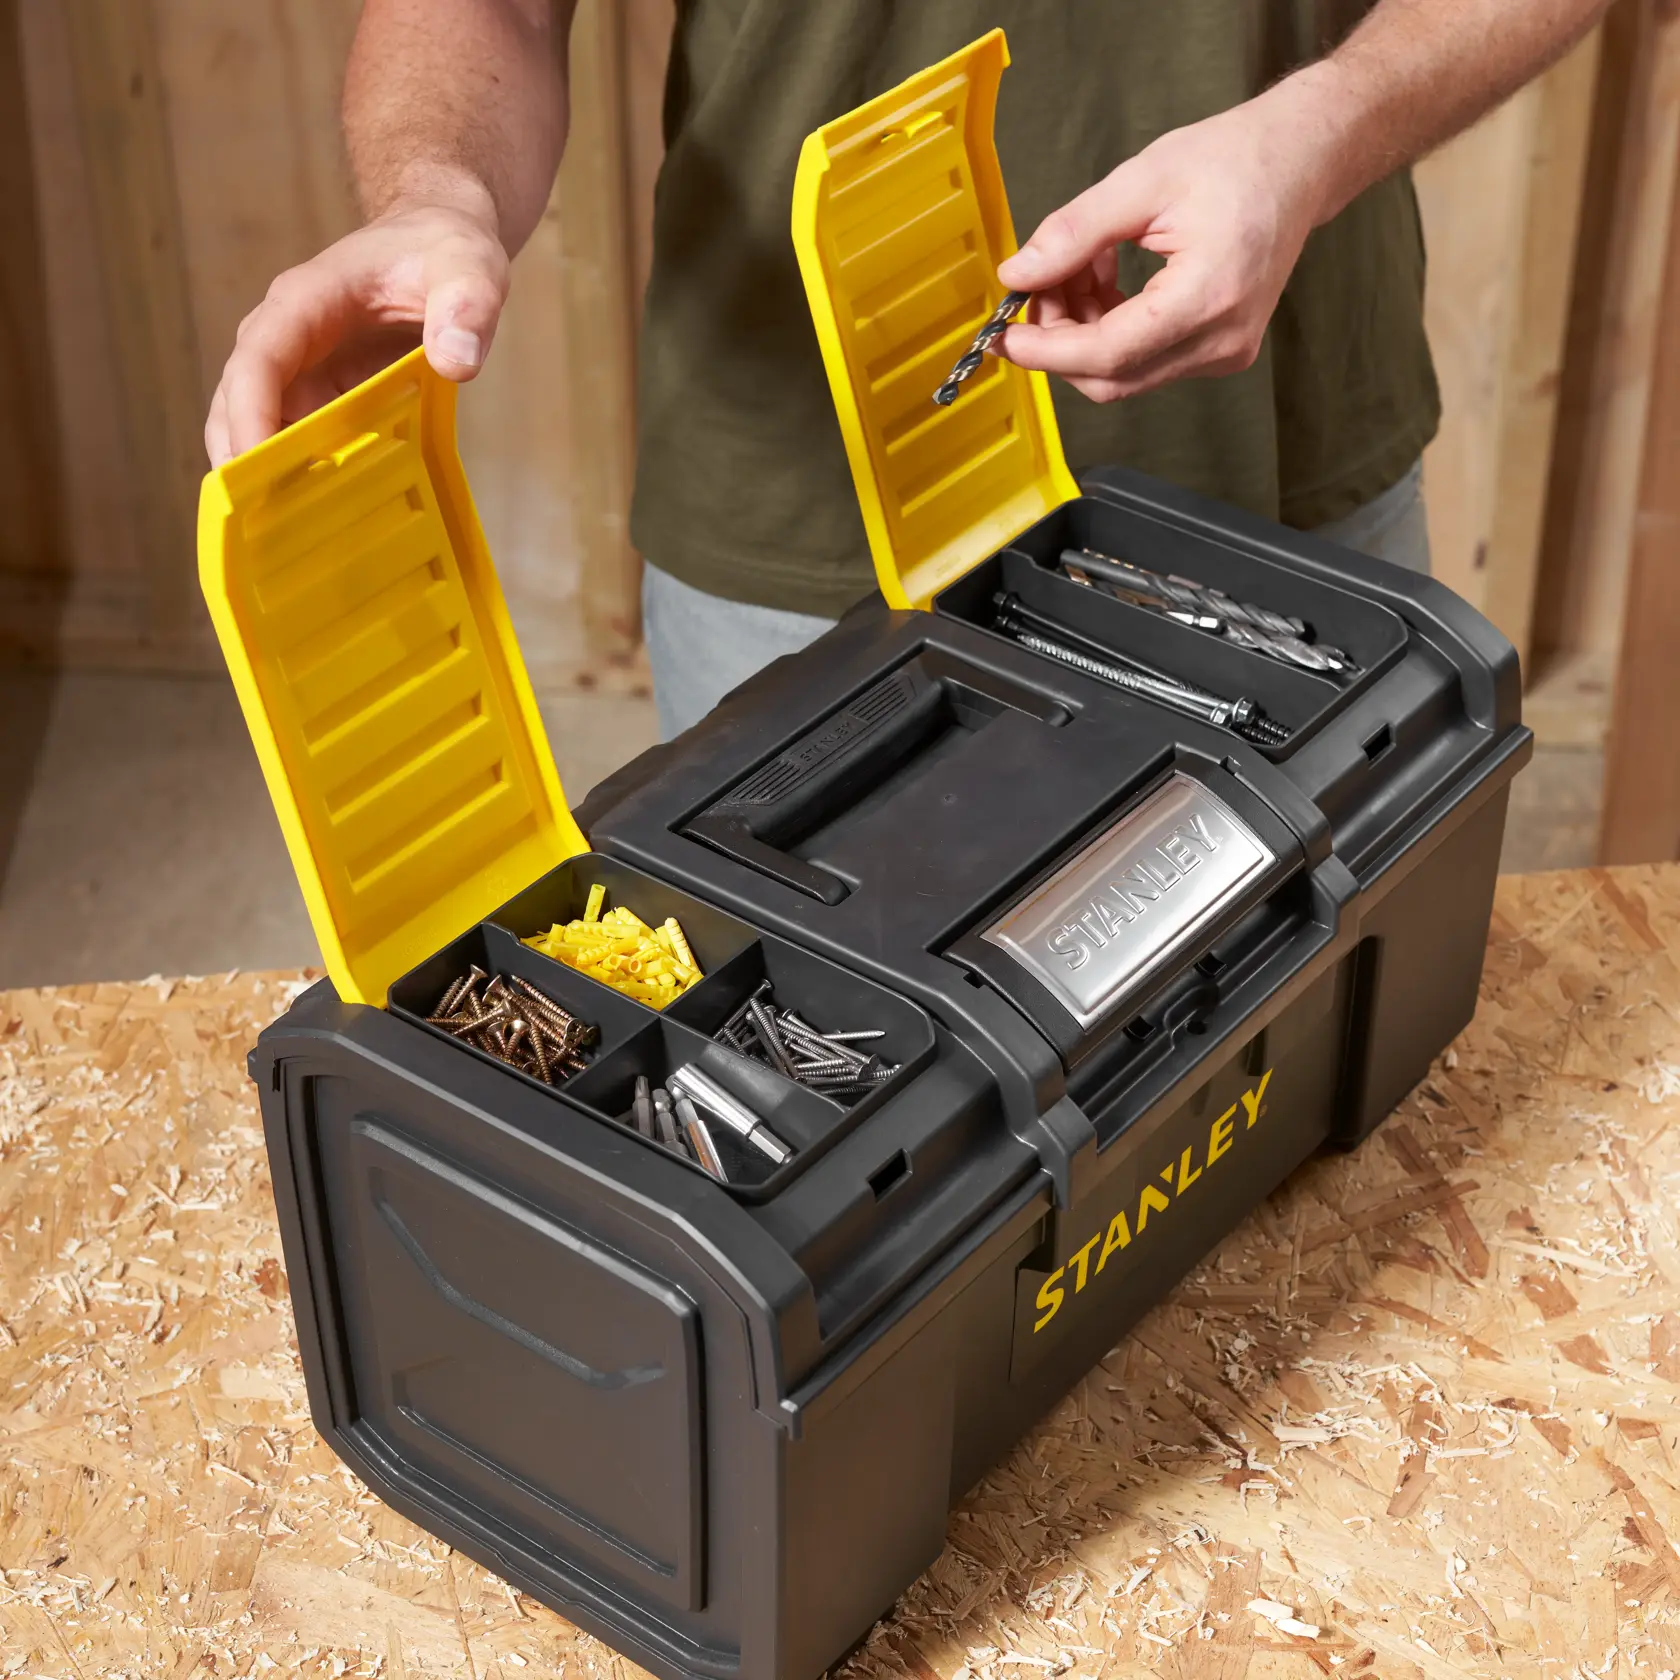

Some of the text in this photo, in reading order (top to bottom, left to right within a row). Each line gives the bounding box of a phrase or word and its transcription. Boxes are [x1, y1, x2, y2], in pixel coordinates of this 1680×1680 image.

[799, 721, 850, 762] STANLEY
[1046, 813, 1218, 970] STANLEY
[1033, 1068, 1273, 1333] STANLEY
